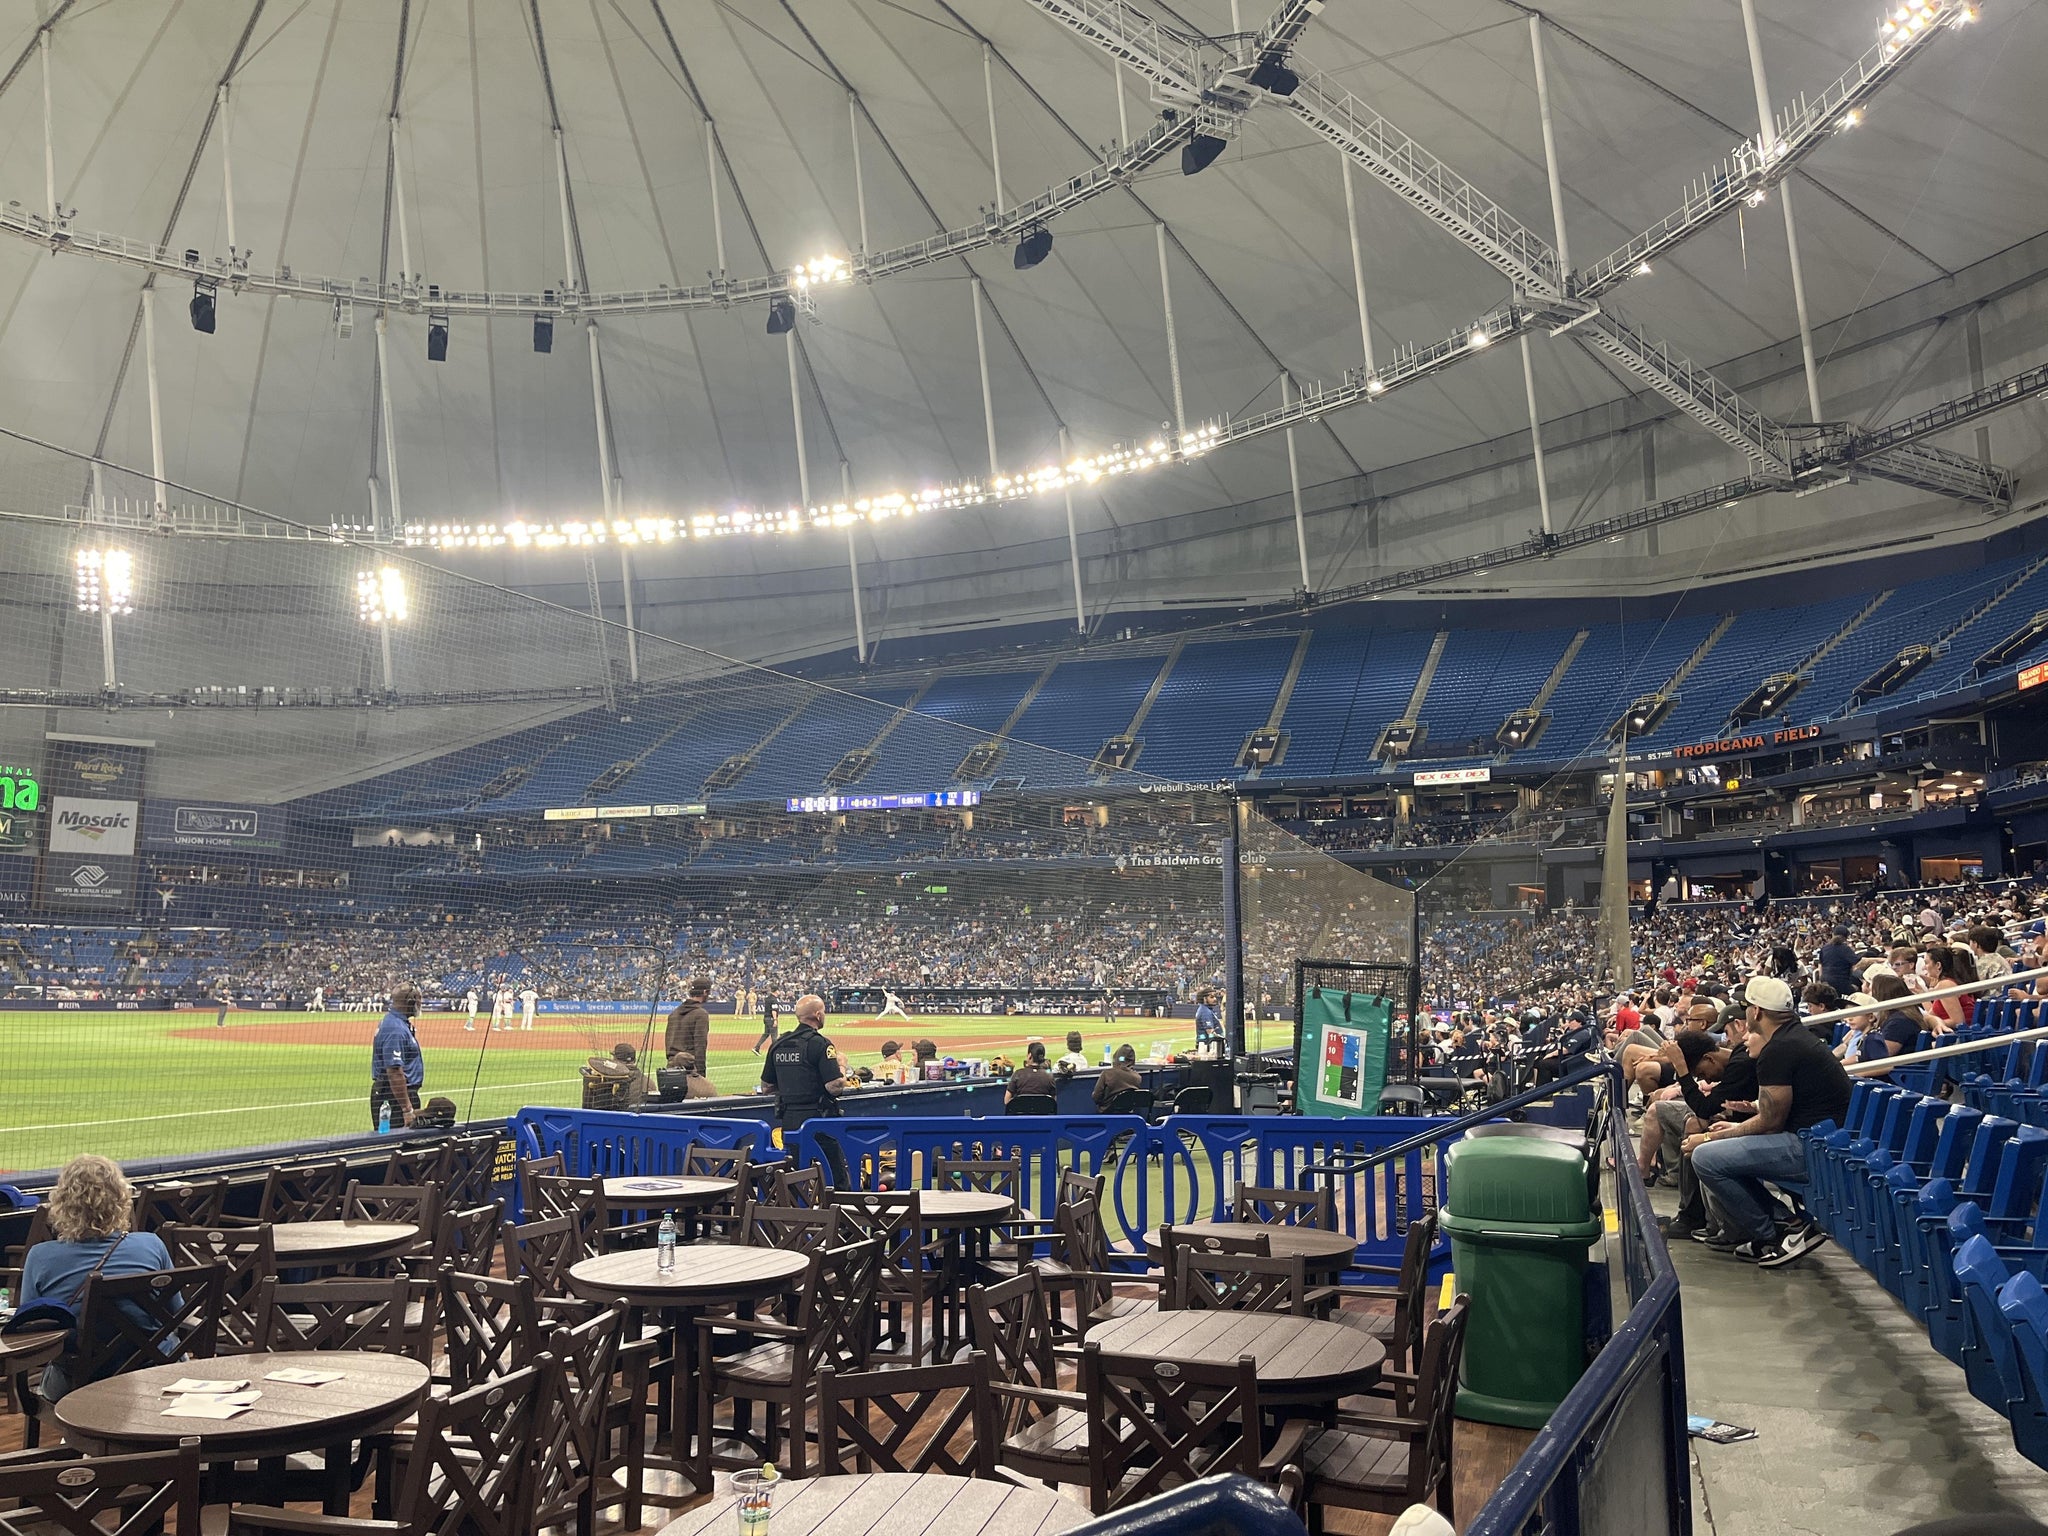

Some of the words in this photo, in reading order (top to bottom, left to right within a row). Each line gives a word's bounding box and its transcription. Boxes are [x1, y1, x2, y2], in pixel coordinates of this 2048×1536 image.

[1674, 735, 1764, 758] TROPICANA
[1774, 725, 1820, 744] FIELD
[1153, 784, 1183, 793] Webull
[1185, 782, 1209, 792] Suite
[57, 811, 129, 828] Mosaic
[175, 836, 204, 845] UNION
[205, 838, 231, 846] HOME
[1130, 856, 1151, 866] The
[1153, 855, 1200, 866] Baldwin
[1240, 854, 1266, 864] Club
[1341, 1036, 1347, 1044] 12
[776, 1053, 800, 1062] POLICE
[501, 1164, 514, 1172] BALLS
